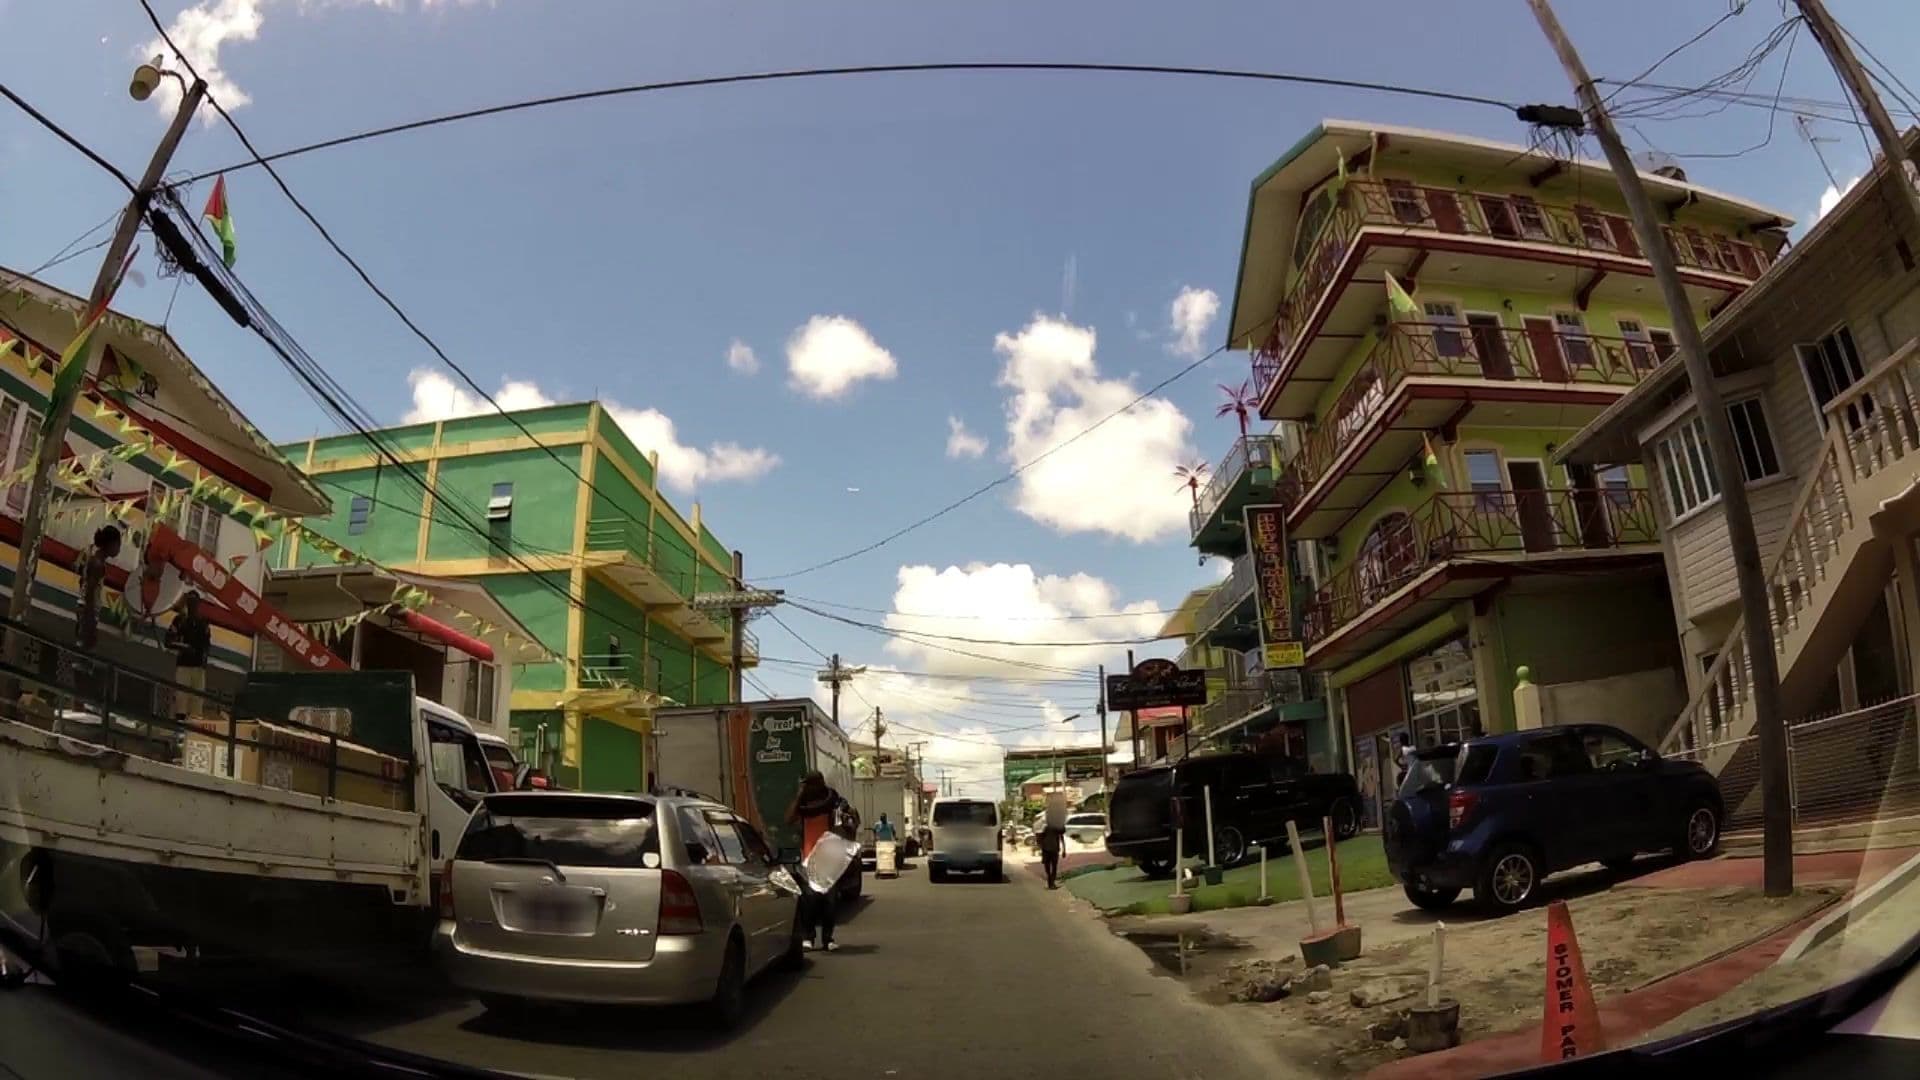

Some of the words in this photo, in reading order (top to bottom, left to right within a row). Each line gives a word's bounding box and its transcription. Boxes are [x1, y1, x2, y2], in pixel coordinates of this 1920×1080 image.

[265, 615, 311, 656] LOVE
[1554, 943, 1575, 1014] STOMER
[1560, 1024, 1577, 1059] PAR
